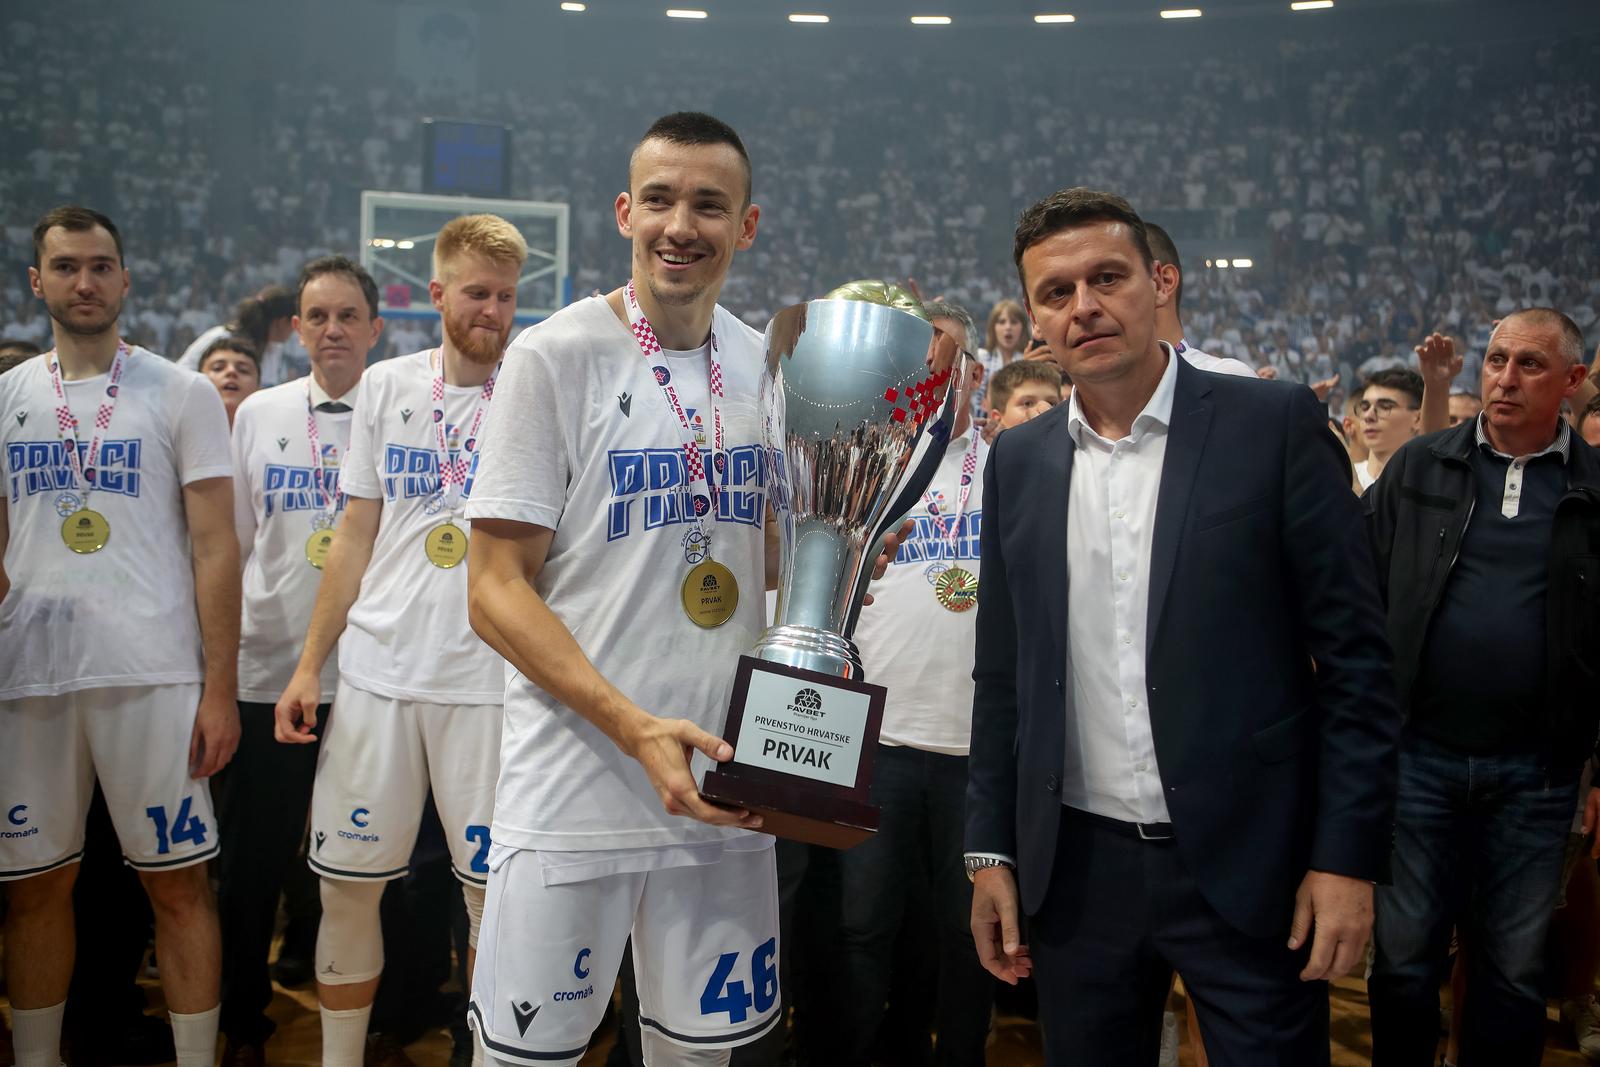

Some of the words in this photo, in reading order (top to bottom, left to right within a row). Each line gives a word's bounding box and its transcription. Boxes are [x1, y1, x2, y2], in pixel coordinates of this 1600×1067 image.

[667, 386, 689, 429] FAVBET
[701, 596, 721, 606] PRVAK
[786, 704, 826, 718] FAVBET
[755, 715, 805, 734] PRVENSTVO
[807, 727, 851, 744] HRVATSKE
[762, 738, 833, 770] PRVAK
[0, 827, 39, 839] romaris
[146, 796, 207, 855] 14
[337, 830, 379, 842] cromaris
[700, 937, 778, 1024] 46
[553, 985, 594, 1001] cromaris
